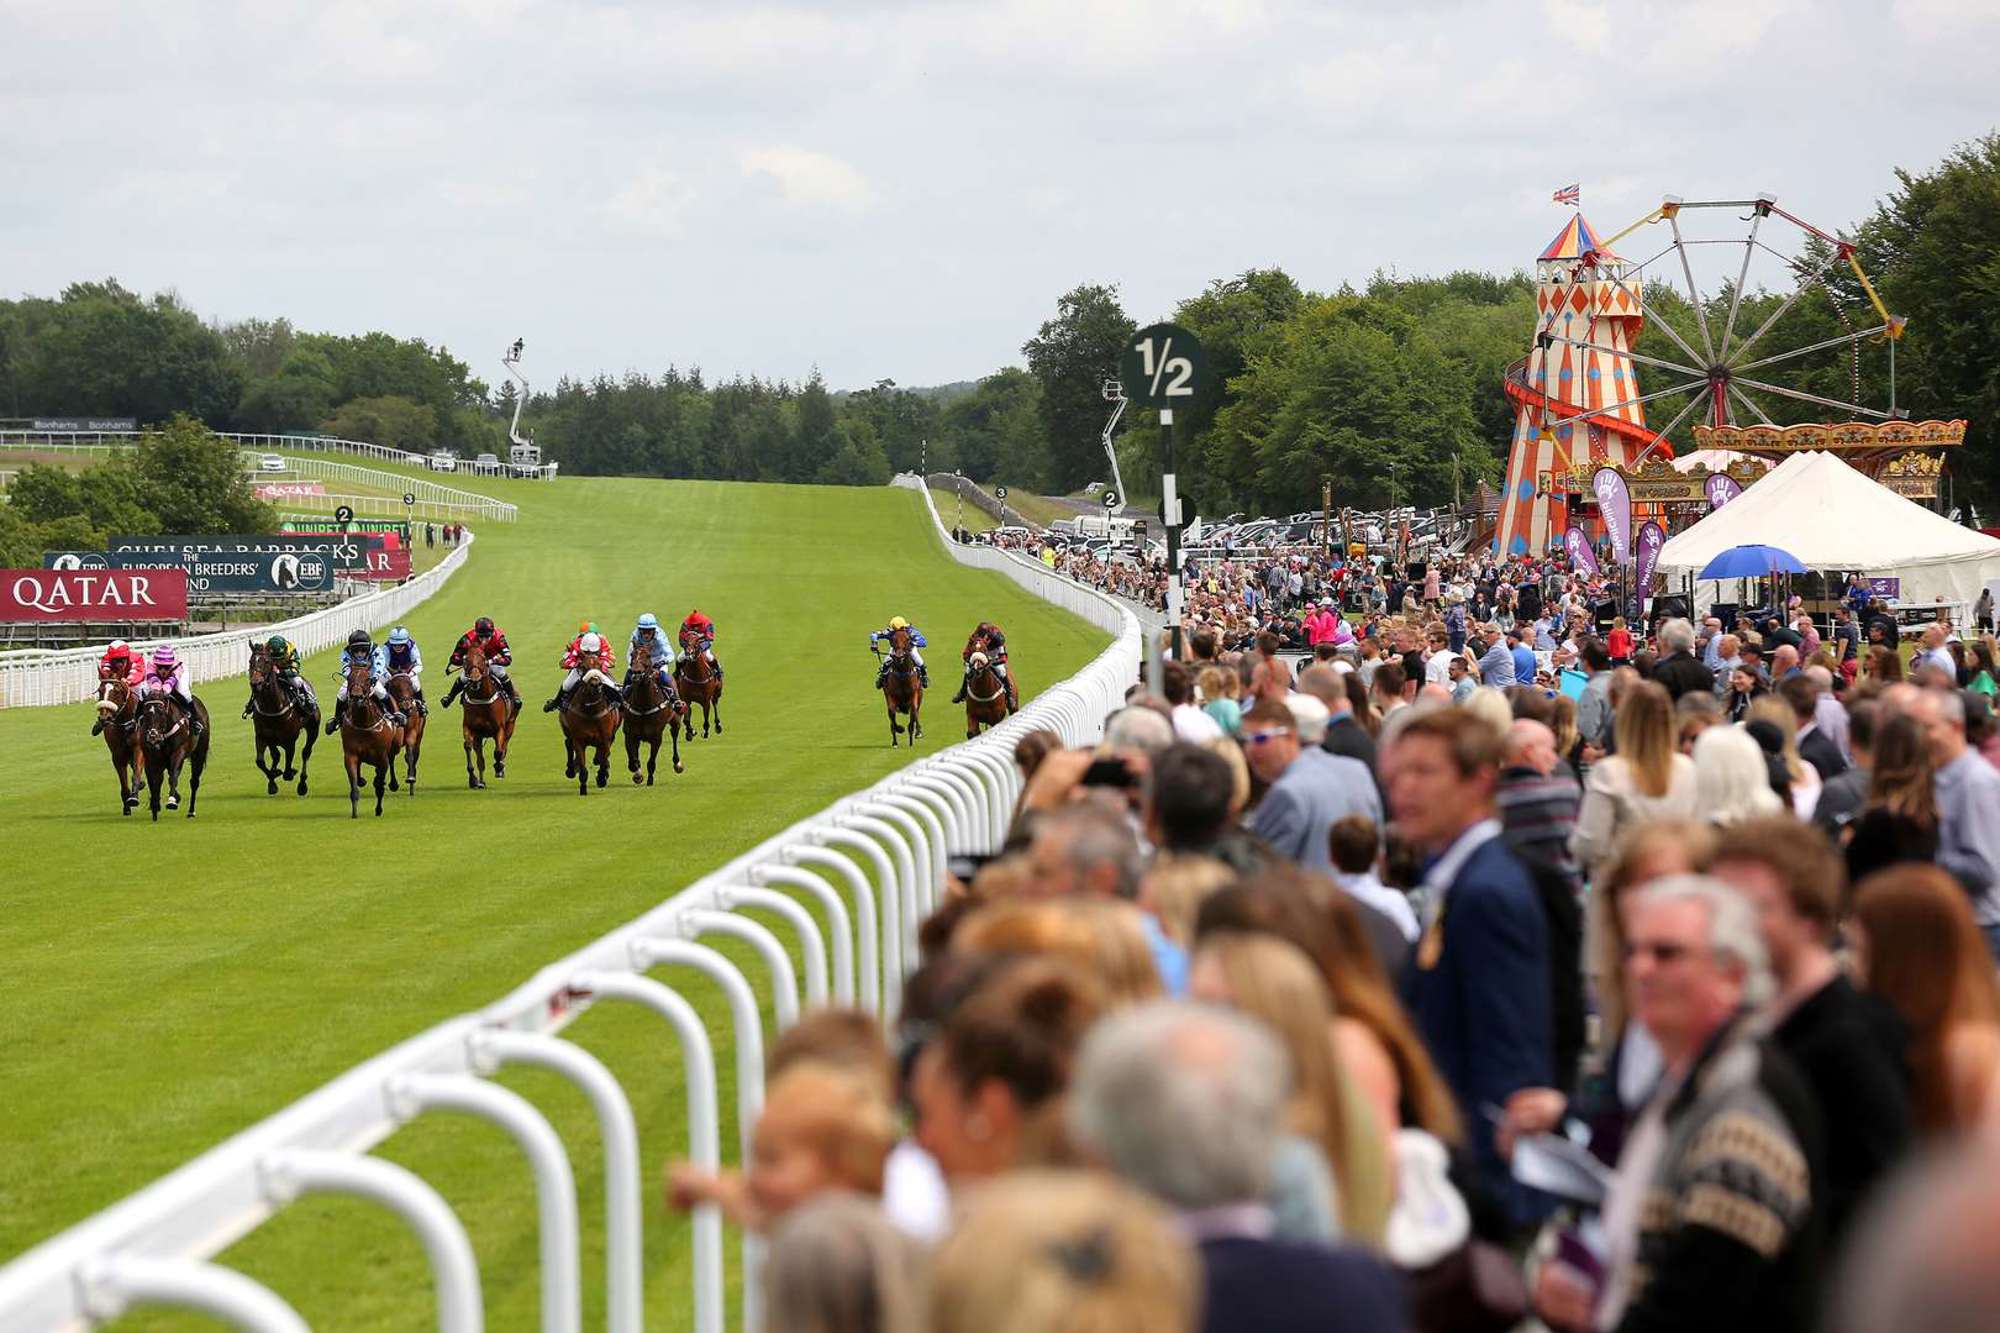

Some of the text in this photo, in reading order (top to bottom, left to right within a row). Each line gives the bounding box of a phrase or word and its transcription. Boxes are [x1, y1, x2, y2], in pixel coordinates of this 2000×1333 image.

[1135, 338, 1193, 396] 1/2
[34, 420, 133, 430] Bonhams Bonhams
[998, 488, 1005, 497] 3
[1105, 492, 1115, 506] 2
[405, 495, 413, 504] 3
[339, 508, 349, 521] 2
[182, 553, 199, 562] THE
[300, 562, 323, 576] EBF
[13, 576, 157, 613] QATAR
